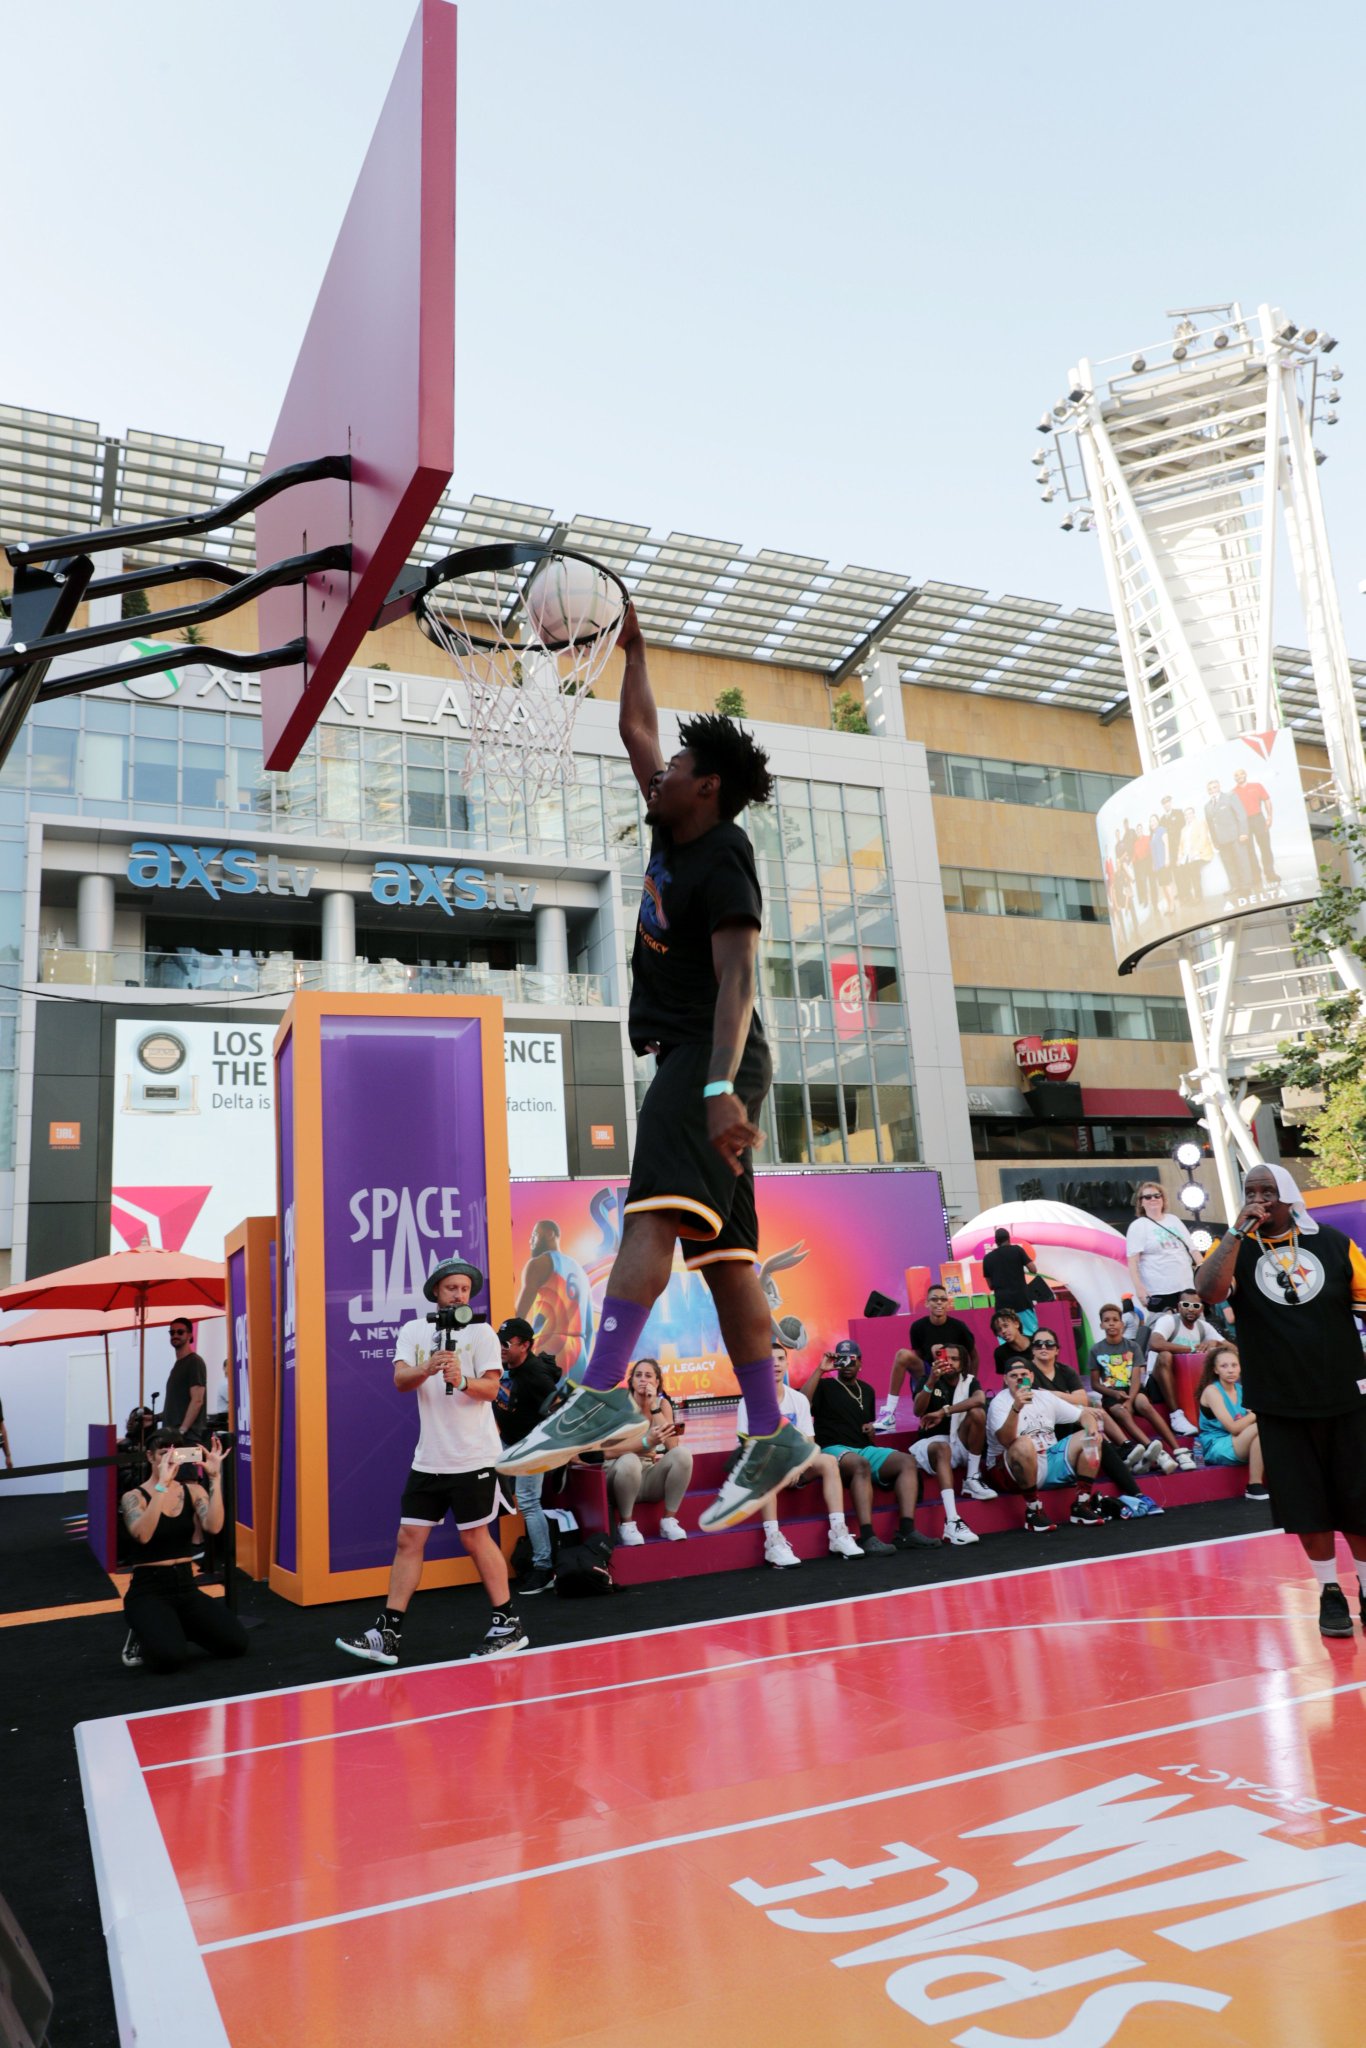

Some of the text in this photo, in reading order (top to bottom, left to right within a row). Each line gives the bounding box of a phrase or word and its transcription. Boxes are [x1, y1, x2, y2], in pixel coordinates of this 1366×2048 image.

[366, 677, 537, 737] PLAZA
[126, 840, 317, 901] axs.tv
[370, 861, 538, 917] axs.tv
[1237, 888, 1288, 907] DELTA
[213, 1031, 263, 1056] LOS
[1016, 1045, 1070, 1066] CONGA
[212, 1061, 267, 1086] THE
[212, 1093, 271, 1109] Delta is
[506, 1097, 557, 1112] faction.
[349, 1186, 463, 1243] SPACE
[349, 1328, 361, 1342] A
[360, 1350, 384, 1359] THE
[673, 1360, 716, 1374] LEGACY
[691, 1374, 712, 1391] 16
[1157, 1763, 1366, 1825] LEGACY
